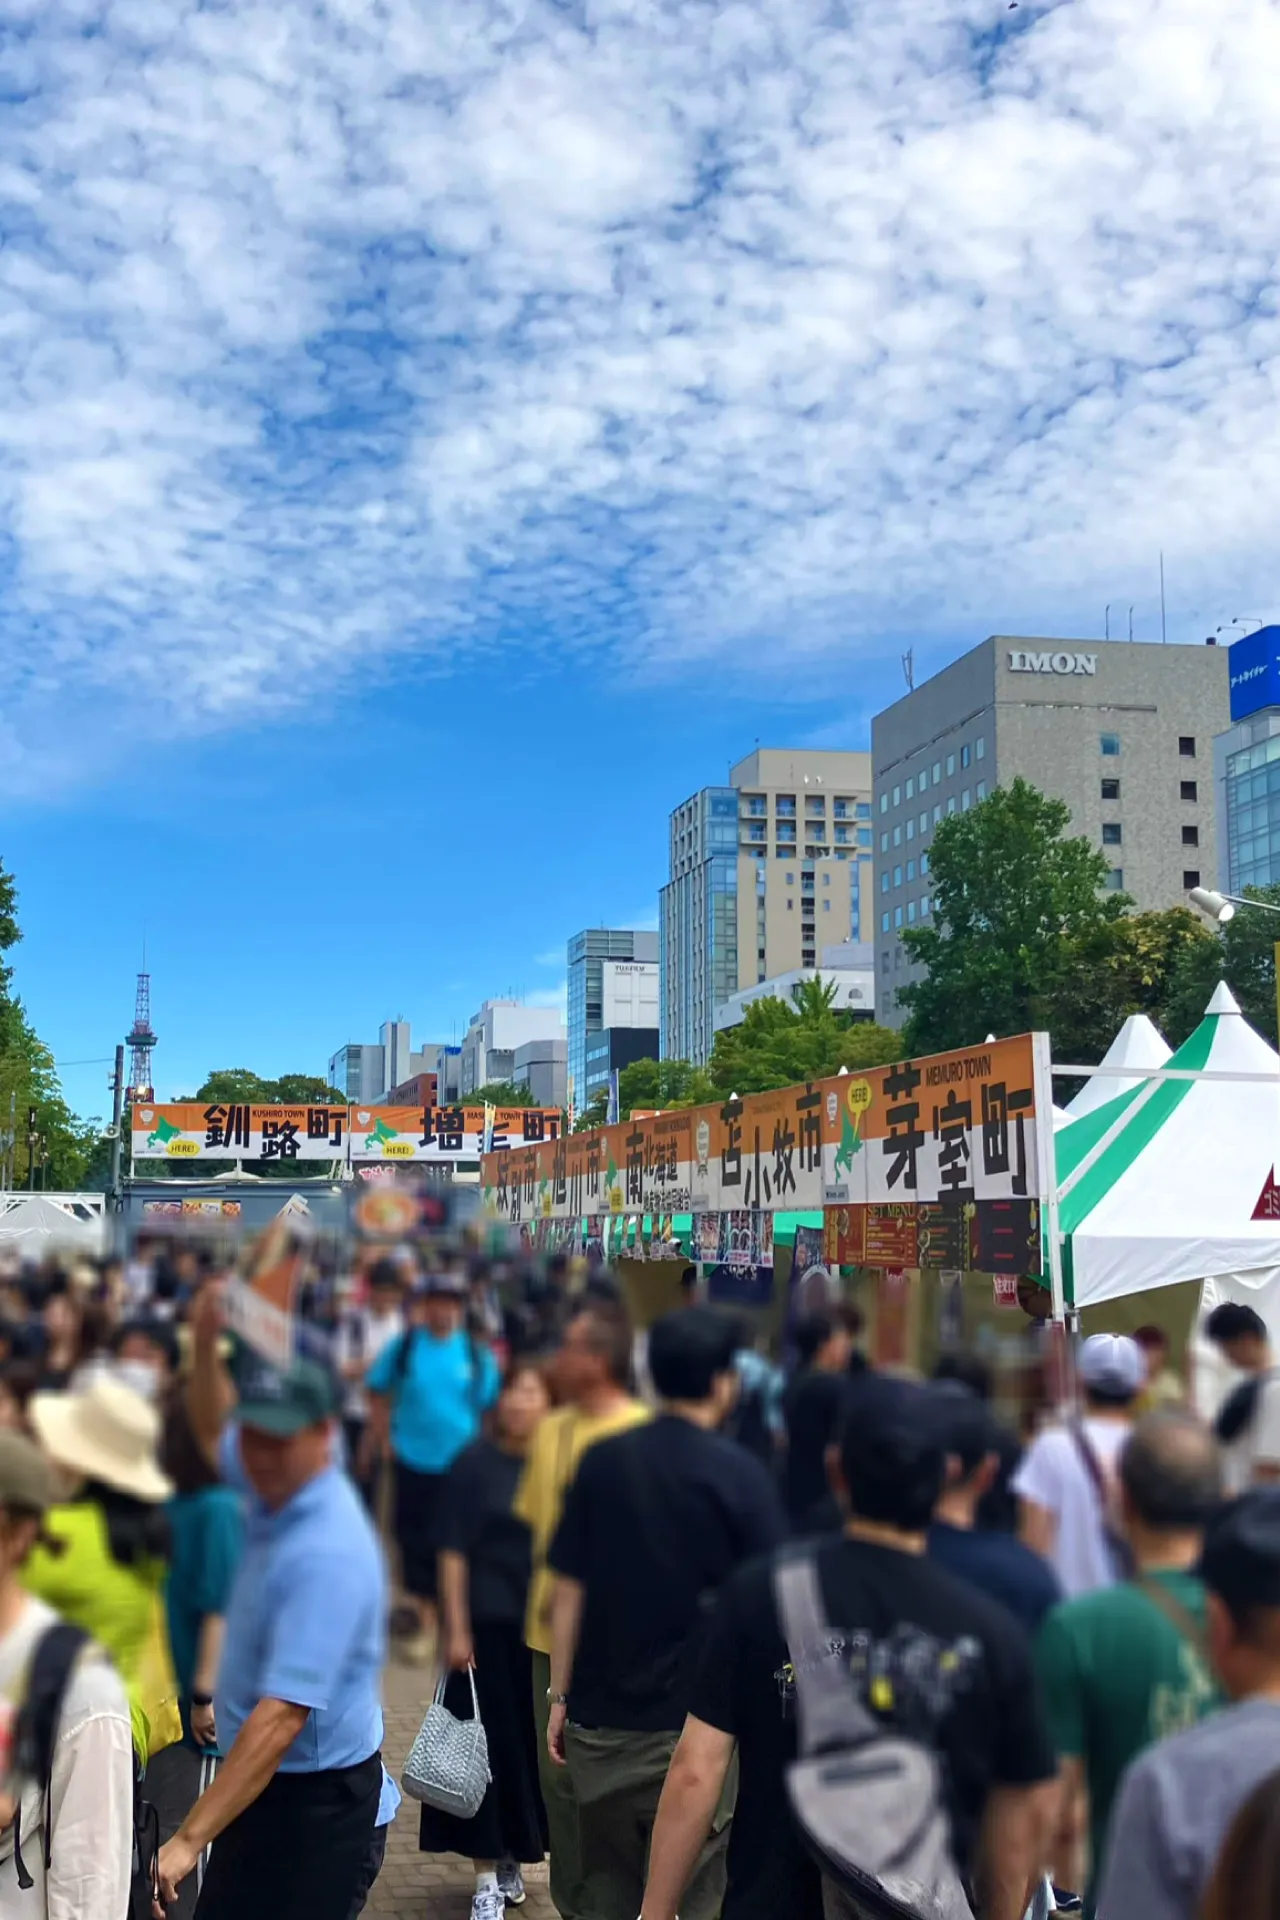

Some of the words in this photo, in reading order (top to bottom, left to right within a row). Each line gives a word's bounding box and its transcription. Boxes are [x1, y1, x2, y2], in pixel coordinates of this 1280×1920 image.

[1008, 651, 1097, 675] IMON
[926, 1063, 963, 1087] MEMURO
[964, 1054, 992, 1079] TOWN
[252, 1110, 282, 1118] KUSHIRO
[284, 1110, 305, 1118] TOWN
[467, 1112, 498, 1120] MASE
[501, 1112, 520, 1120] TOWN
[203, 1105, 347, 1159] 釧路町
[883, 1062, 1033, 1202] 芽室町
[171, 1145, 195, 1153] HERE!
[386, 1146, 409, 1154] HERE!
[720, 1082, 821, 1209] 苫小牧市
[887, 1203, 916, 1217] MENU
